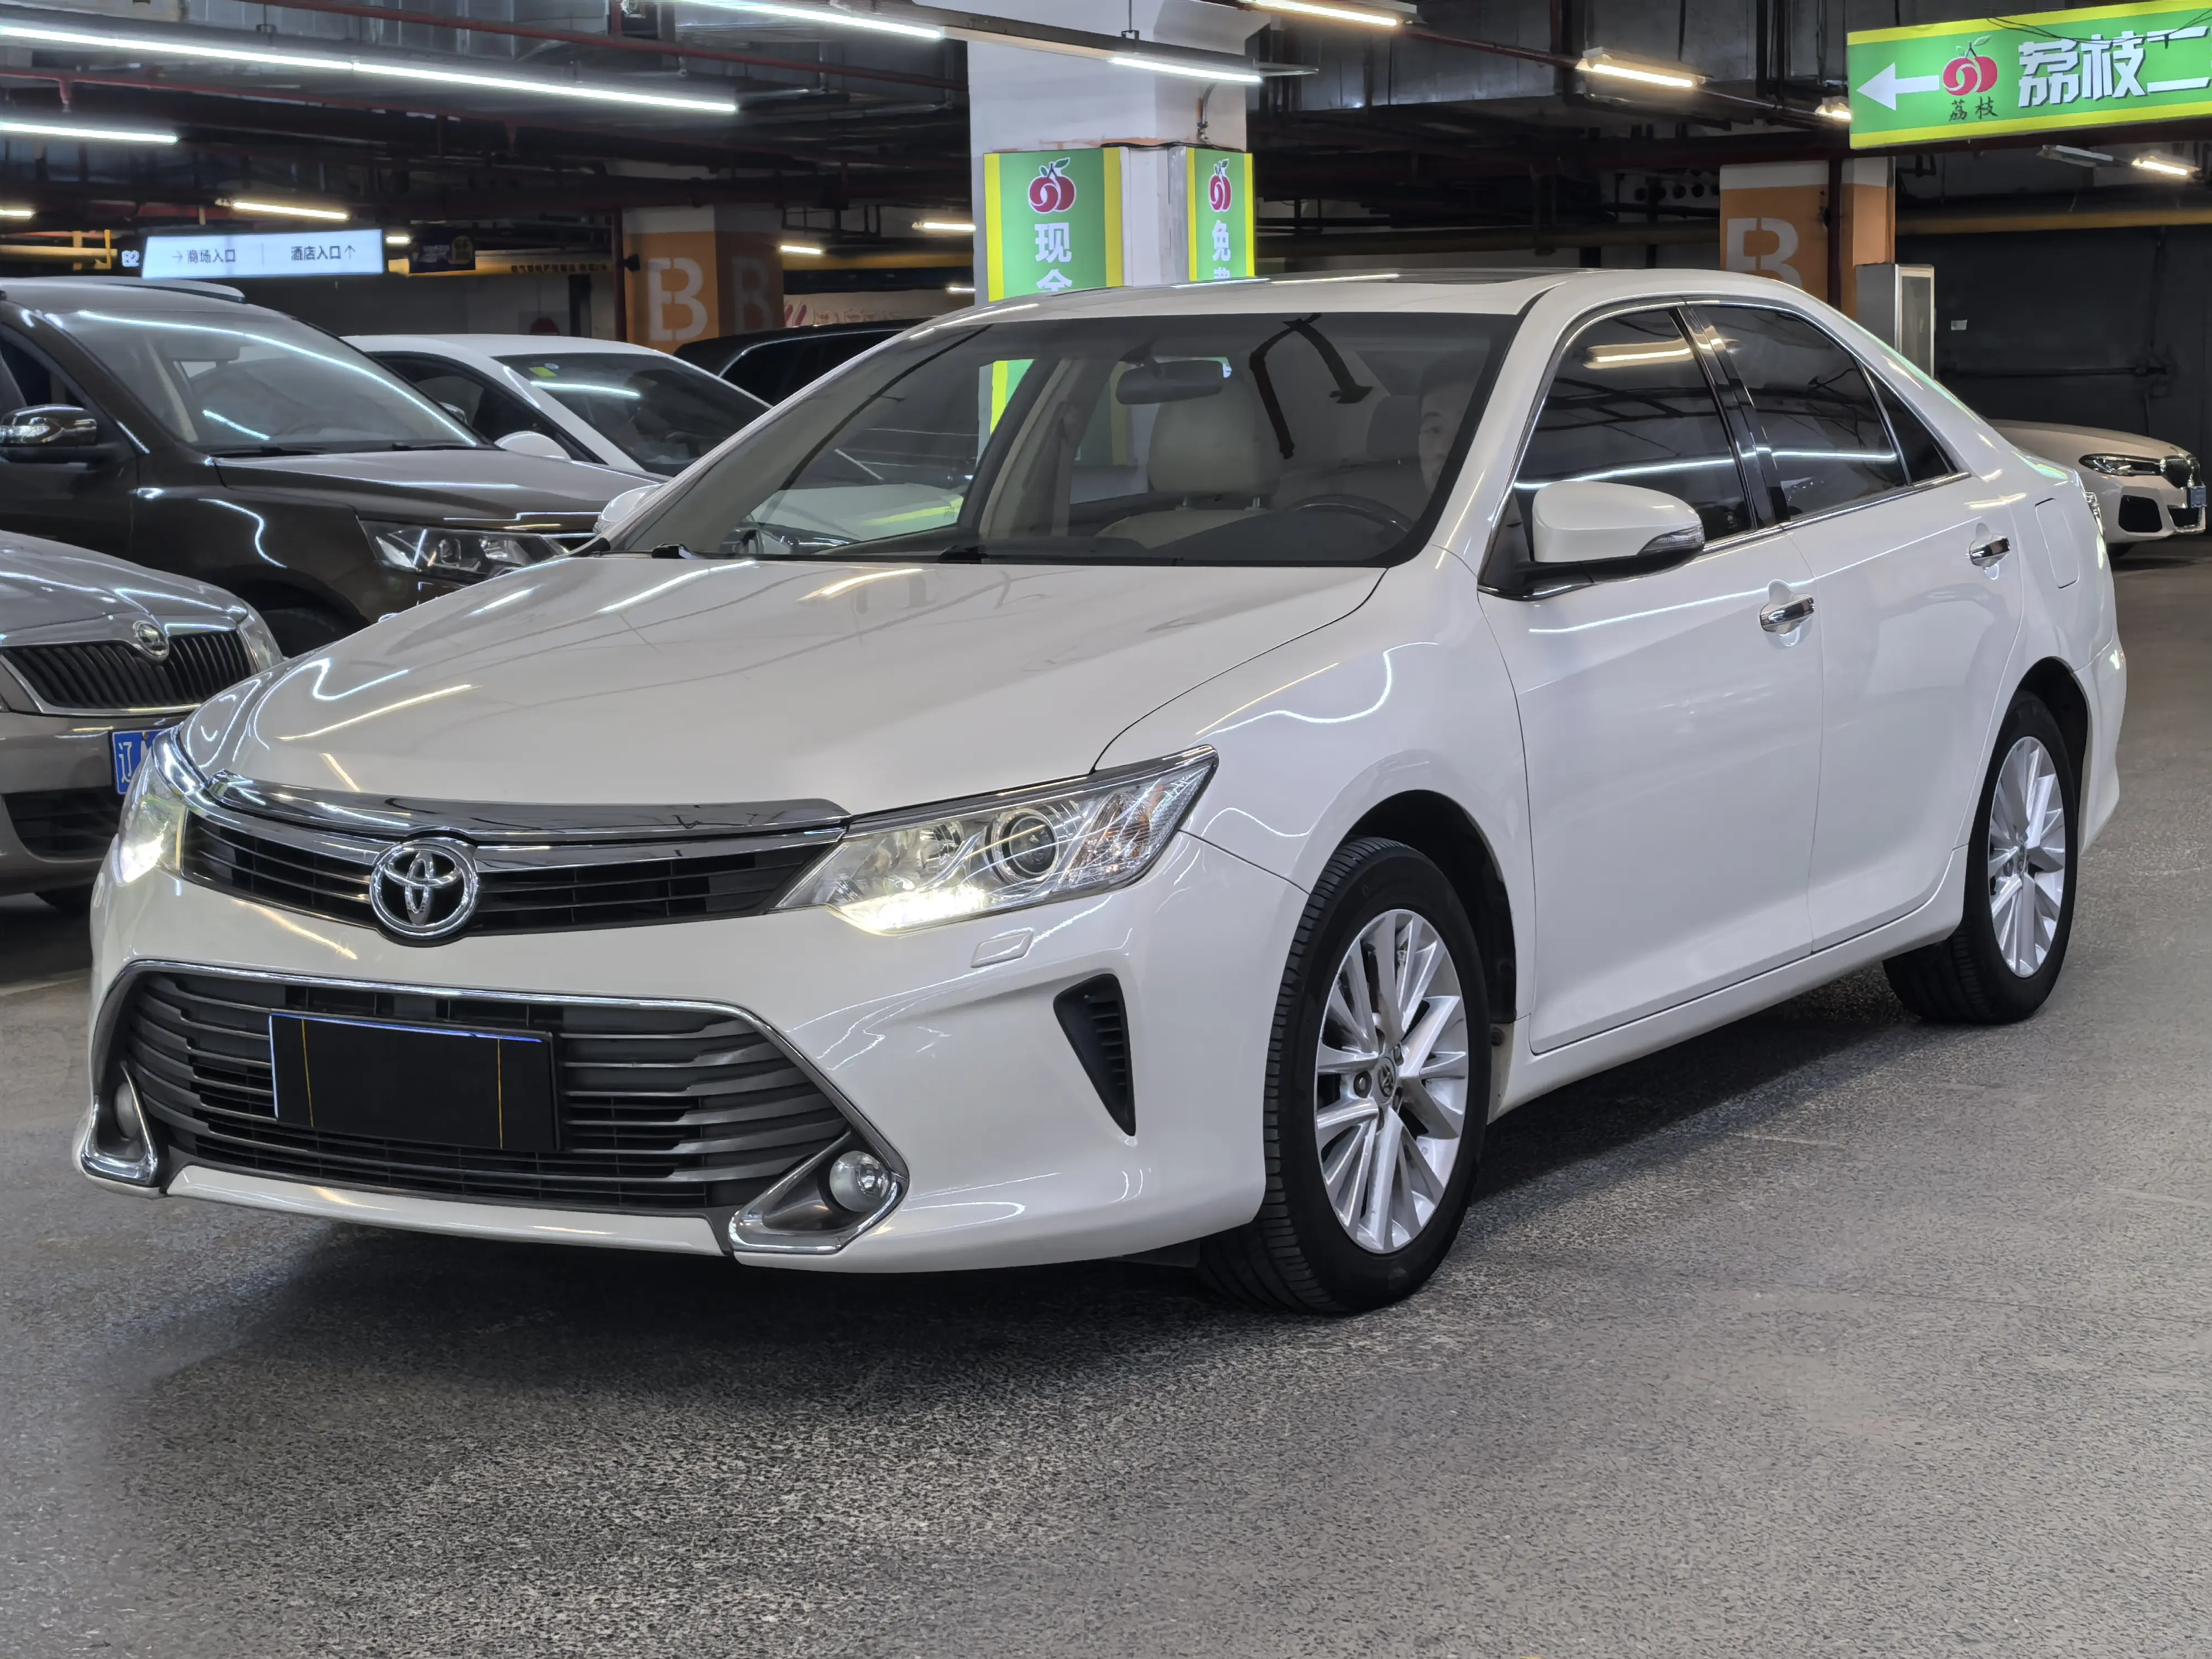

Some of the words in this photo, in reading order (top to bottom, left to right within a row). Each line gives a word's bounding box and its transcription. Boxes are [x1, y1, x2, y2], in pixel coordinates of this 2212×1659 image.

[2018, 25, 2212, 108] 荔枝二
[1949, 96, 1999, 122] 荔枝
[187, 249, 237, 264] 商场入口
[291, 245, 342, 261] 酒店入口
[1212, 220, 1231, 279] 免
[648, 257, 708, 341] B
[119, 740, 153, 784] 辽
